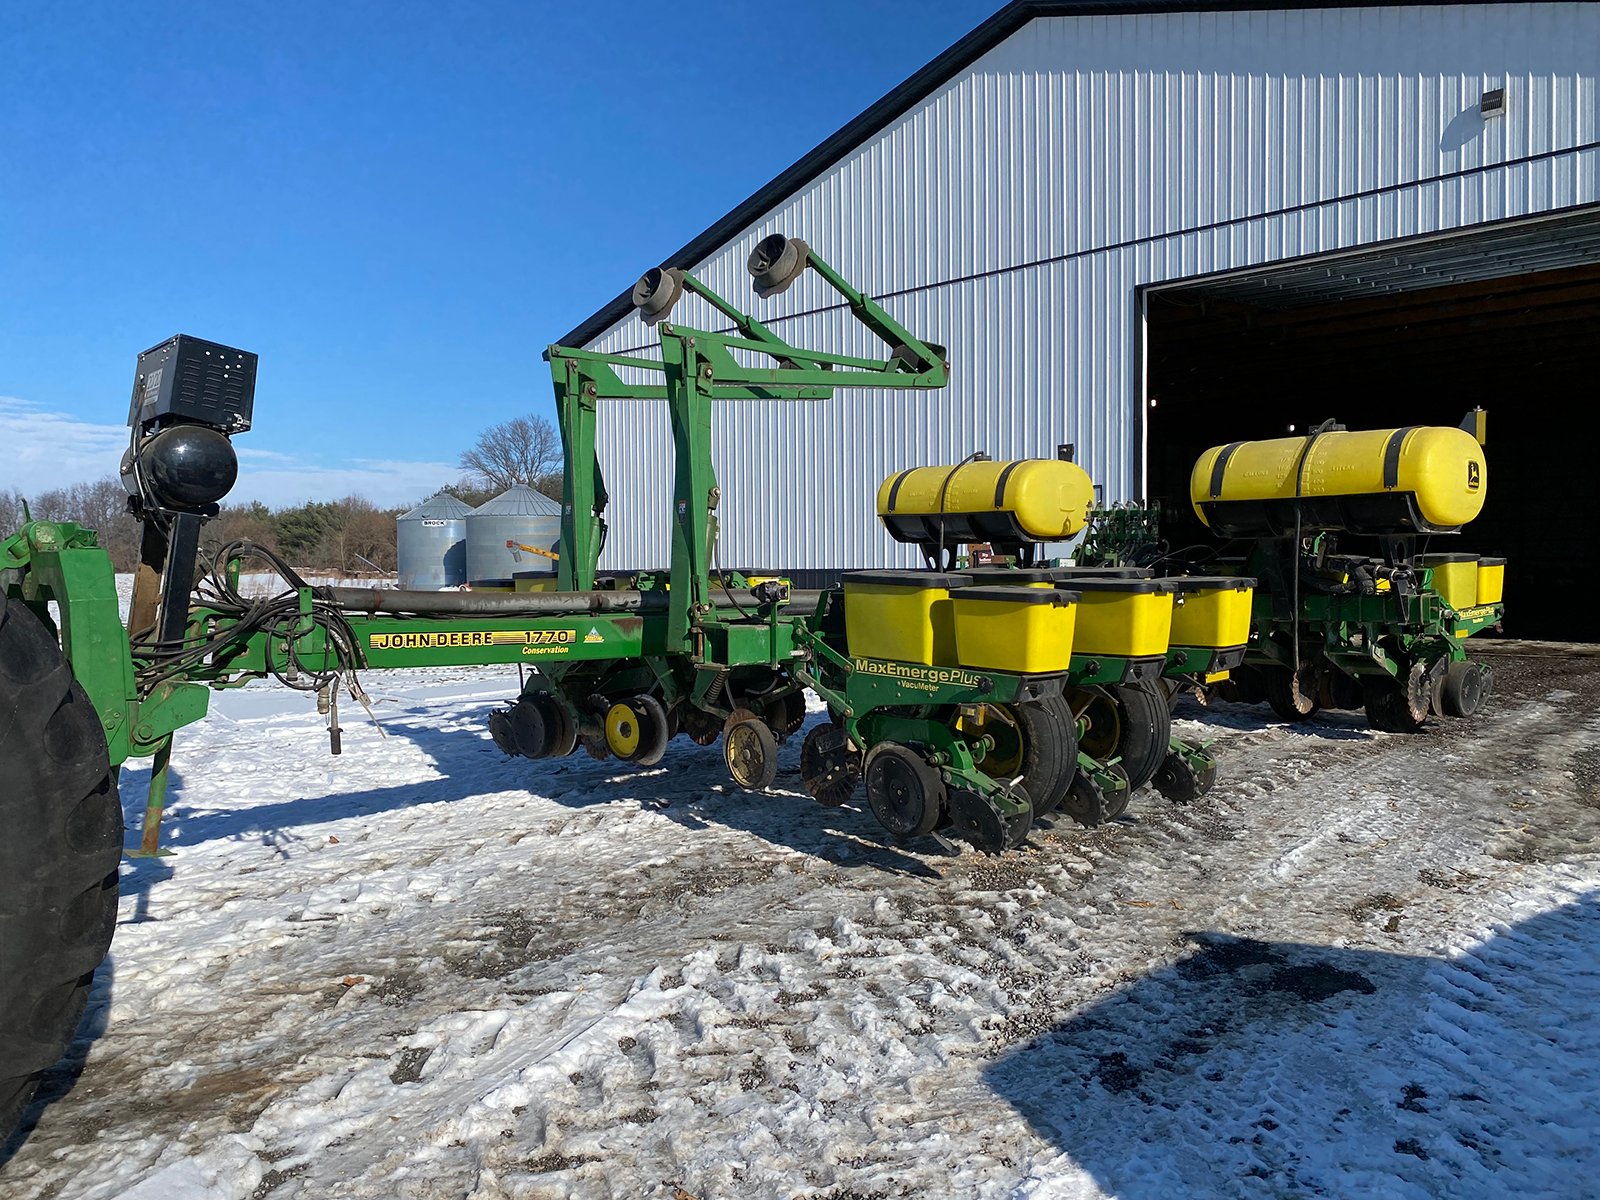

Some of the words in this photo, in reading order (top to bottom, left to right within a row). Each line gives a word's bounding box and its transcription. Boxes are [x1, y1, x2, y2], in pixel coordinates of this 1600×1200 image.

[379, 634, 430, 649] JOHN
[436, 632, 494, 646] DEERE
[524, 630, 569, 644] 1770
[522, 646, 569, 655] Conservation
[901, 680, 939, 692] VacuMeter
